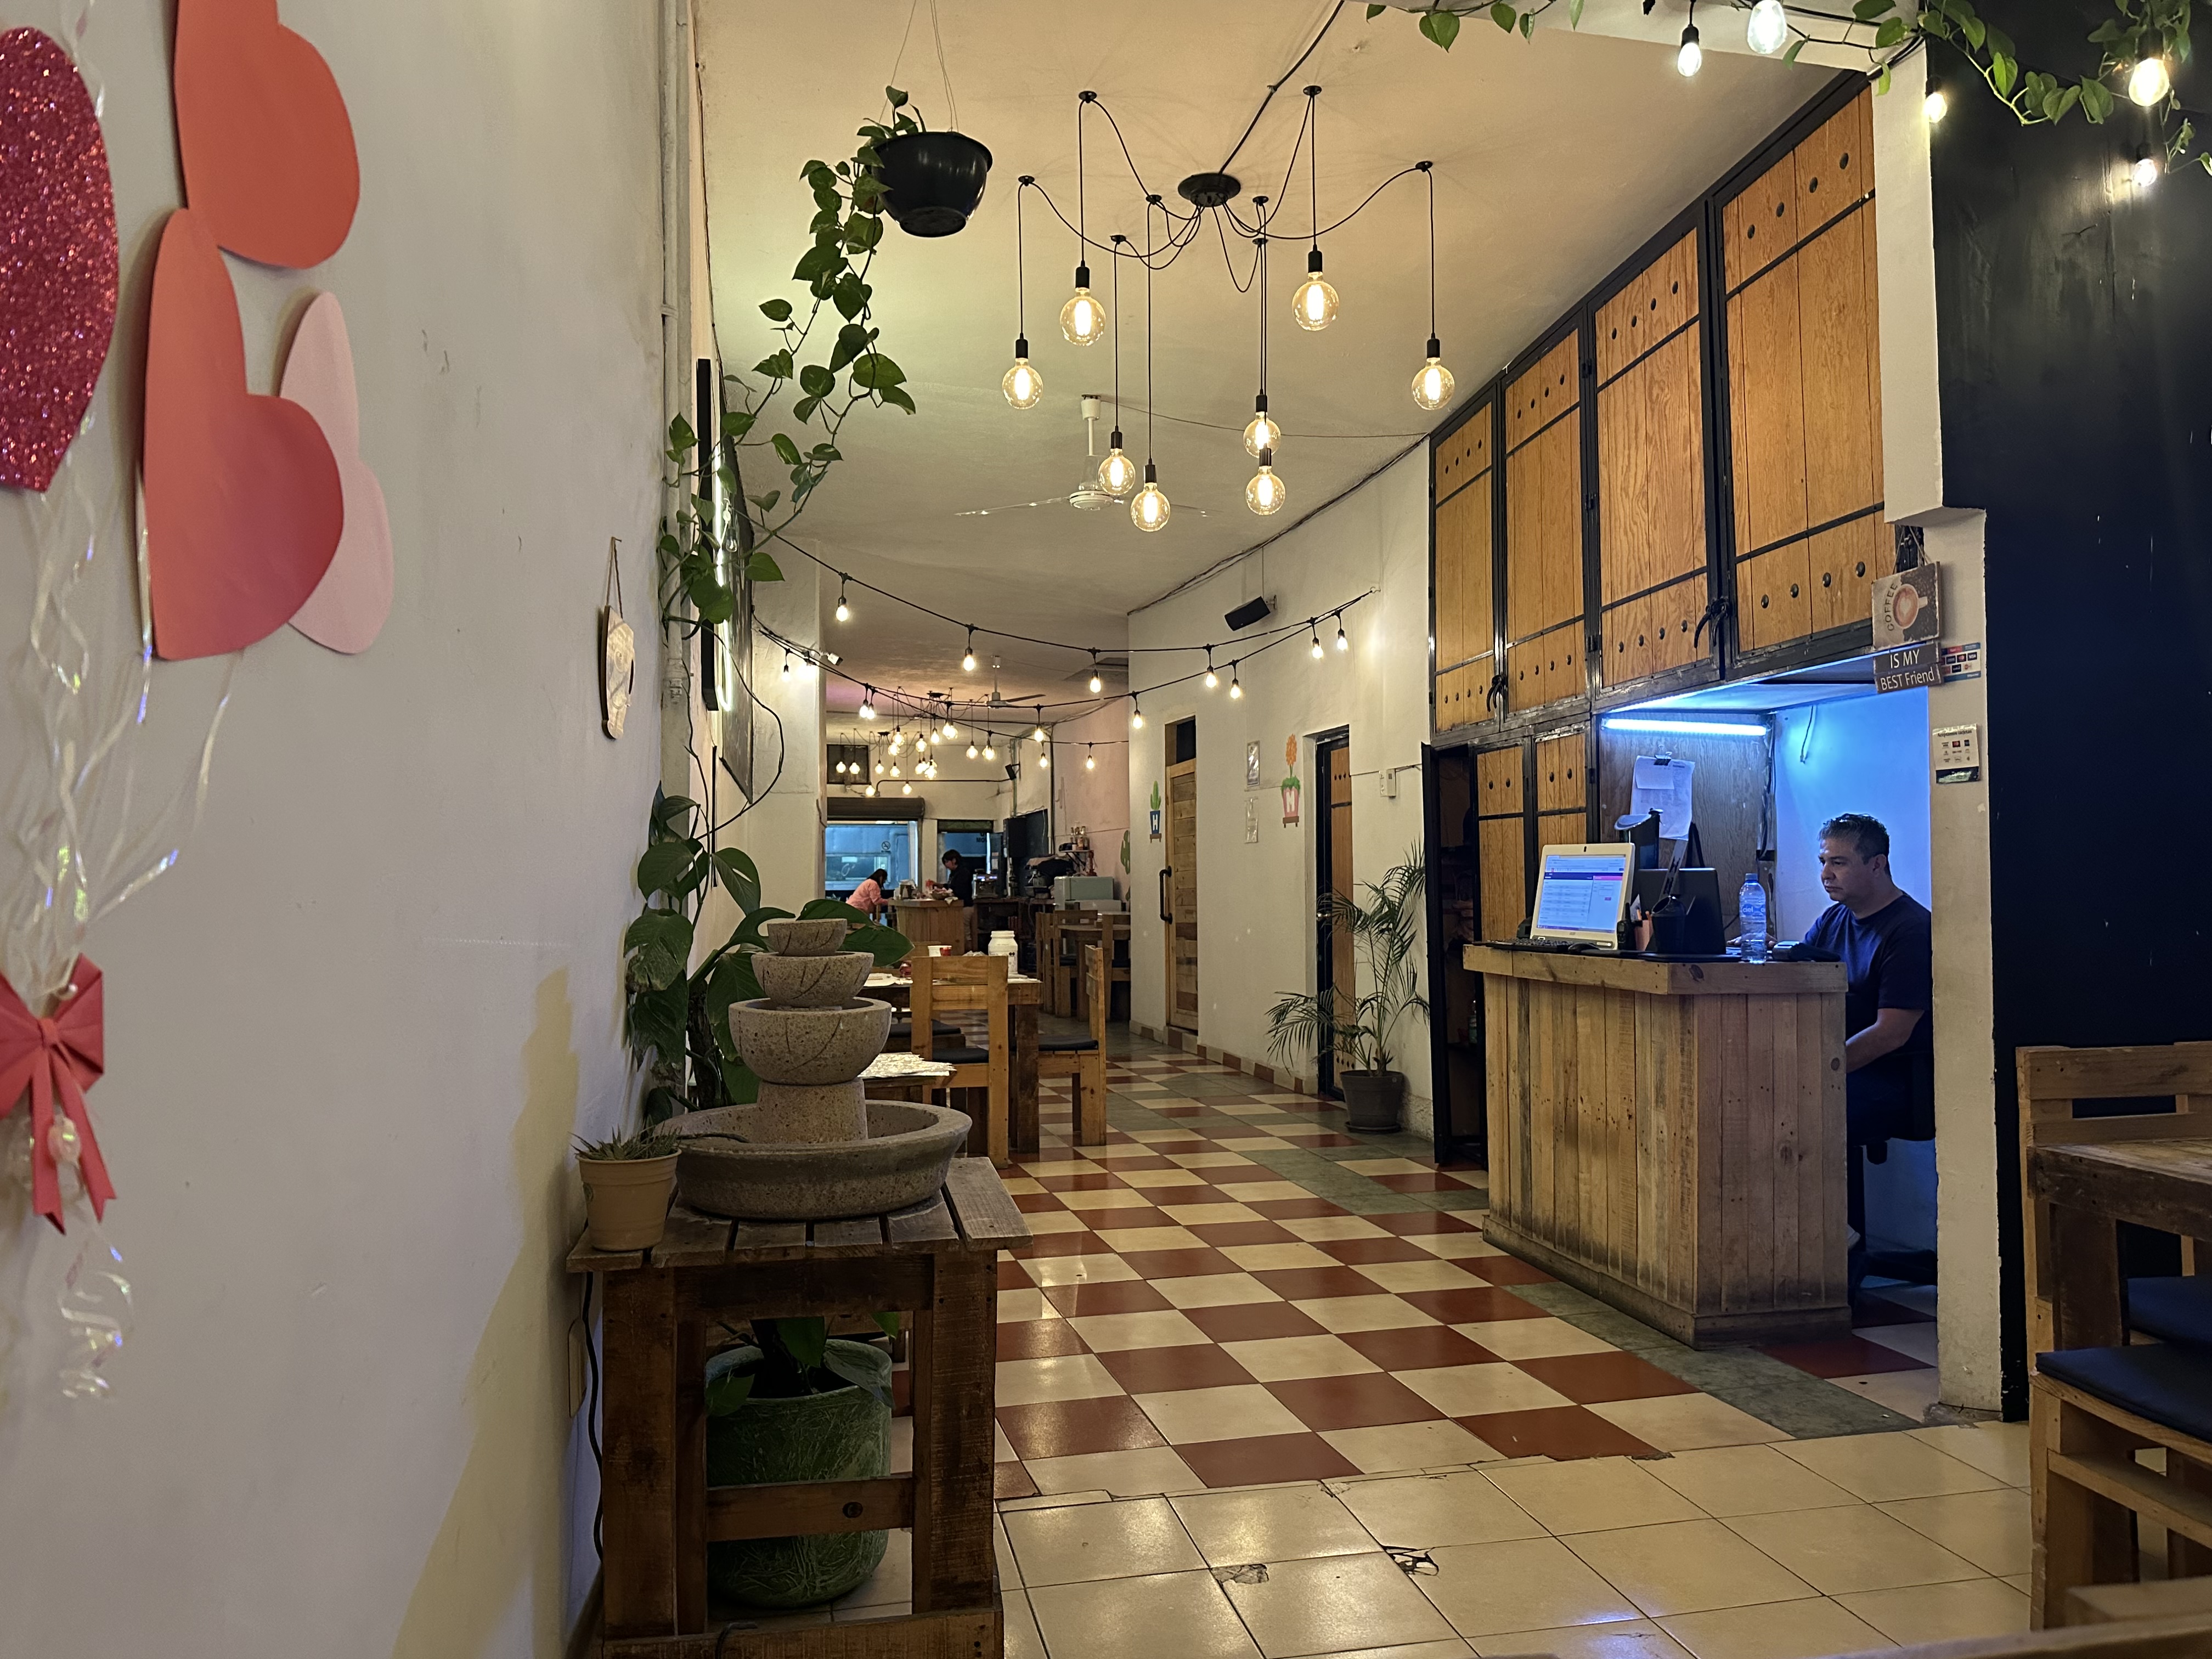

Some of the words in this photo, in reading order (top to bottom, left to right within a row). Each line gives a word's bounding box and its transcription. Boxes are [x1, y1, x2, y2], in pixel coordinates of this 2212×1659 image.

[1884, 583, 1898, 631] COFFEE
[1890, 653, 1899, 669] IS
[1903, 648, 1920, 667] MY
[1880, 673, 1903, 691] BEST
[1904, 666, 1935, 686] Friend
[1286, 790, 1295, 812] M
[1152, 814, 1158, 831] H
